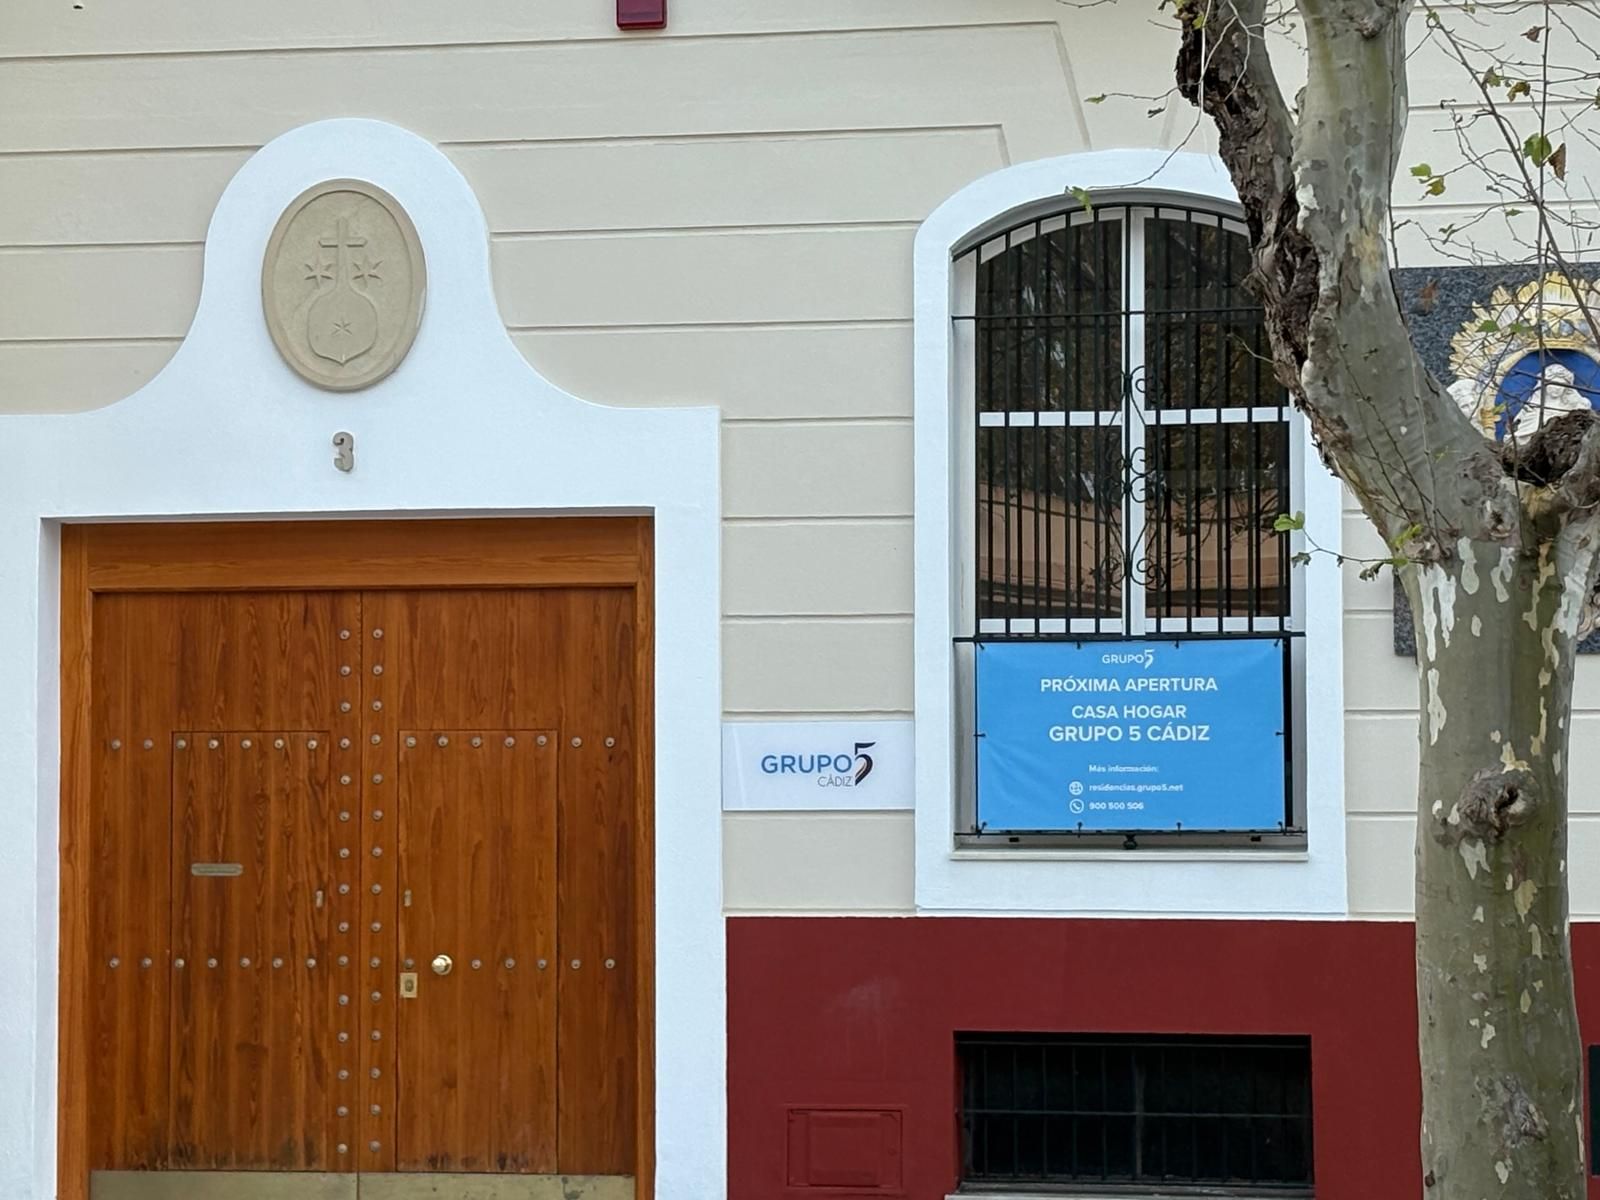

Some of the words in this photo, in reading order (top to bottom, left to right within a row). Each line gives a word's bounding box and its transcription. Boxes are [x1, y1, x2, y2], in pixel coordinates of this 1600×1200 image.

[333, 431, 354, 473] 3
[1040, 675, 1121, 692] PRÓXIMA
[1125, 677, 1218, 692] APERTURA
[1071, 705, 1119, 719] CASA
[1123, 705, 1187, 719] HOGAR
[1049, 725, 1123, 742] GRUPO
[1129, 725, 1141, 741] 5
[1147, 722, 1210, 741] CÁDIZ
[817, 775, 854, 787] CÁDIZ
[1089, 784, 1184, 793] residencias.grupo5.net
[1089, 802, 1106, 810] 900
